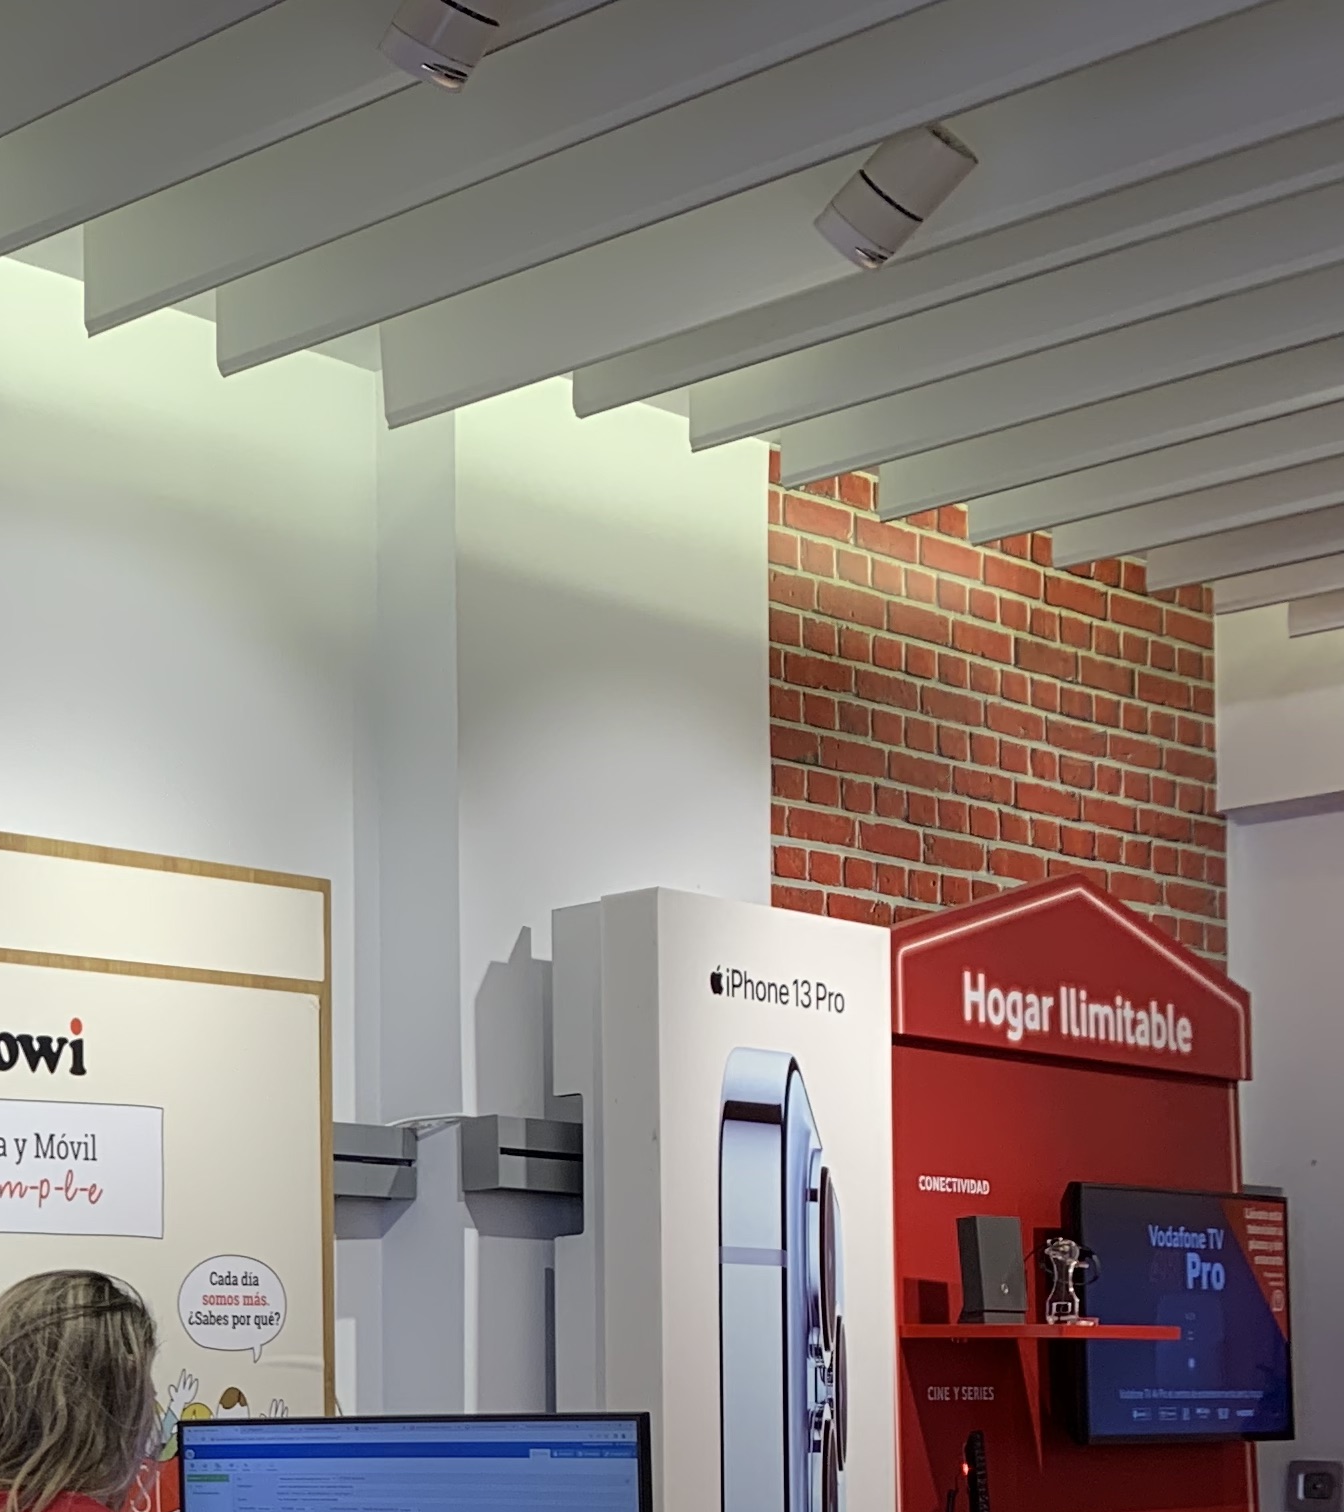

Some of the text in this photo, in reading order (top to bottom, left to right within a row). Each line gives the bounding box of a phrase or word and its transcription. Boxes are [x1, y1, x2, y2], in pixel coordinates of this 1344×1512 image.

[726, 968, 845, 1014] iPhone 13 Pro
[963, 970, 1193, 1054] Hogar Ilimitable
[13, 1137, 27, 1165] y
[33, 1133, 97, 1162] Móvil
[918, 1175, 990, 1195] CONECTIVIDAD
[1148, 1224, 1225, 1250] Vodafone TV
[209, 1271, 259, 1286] Cada día
[1186, 1252, 1226, 1290] Pro
[202, 1294, 240, 1306] somos
[188, 1311, 281, 1329] ¿Sabes por qué?
[927, 1386, 995, 1401] CINE Y SERIES
